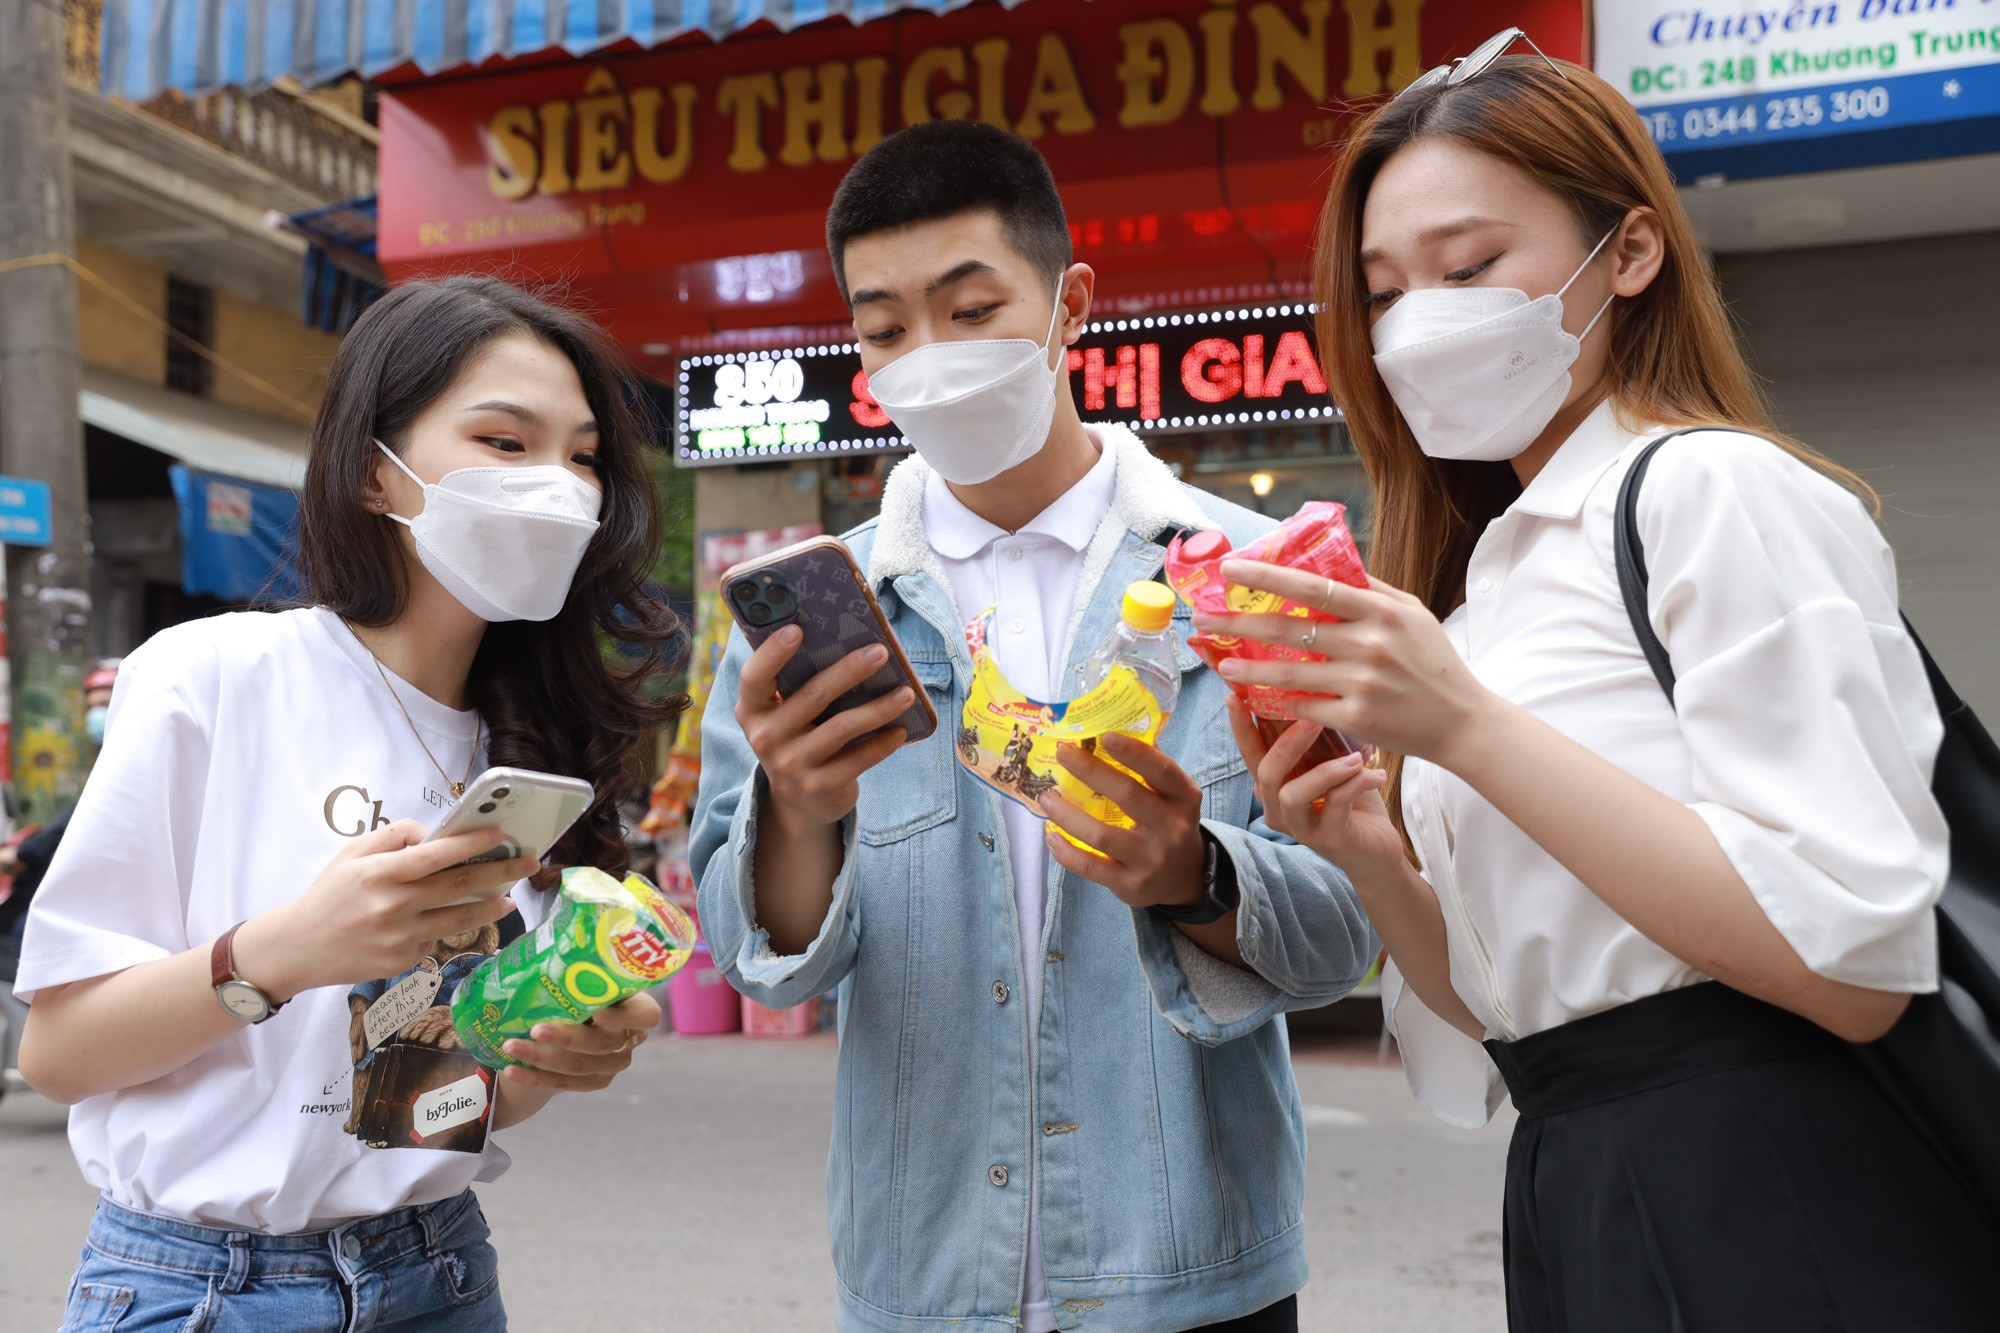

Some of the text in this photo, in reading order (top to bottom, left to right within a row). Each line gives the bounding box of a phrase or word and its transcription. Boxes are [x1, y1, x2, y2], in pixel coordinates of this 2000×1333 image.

[1652, 4, 1839, 47] Chuyên
[1701, 57, 1756, 86] 248
[488, 67, 698, 200] SIÊU
[904, 36, 1095, 140] GIA
[1683, 105, 1758, 139] 0344
[1765, 94, 1824, 130] 235
[1830, 86, 1890, 122] 300
[1181, 331, 1327, 403] GIA
[368, 977, 420, 1024] Please look
[406, 1001, 425, 1021] thank
[540, 974, 571, 1008] KHÔNG
[369, 994, 416, 1034] after this
[299, 1098, 352, 1116] newyork
